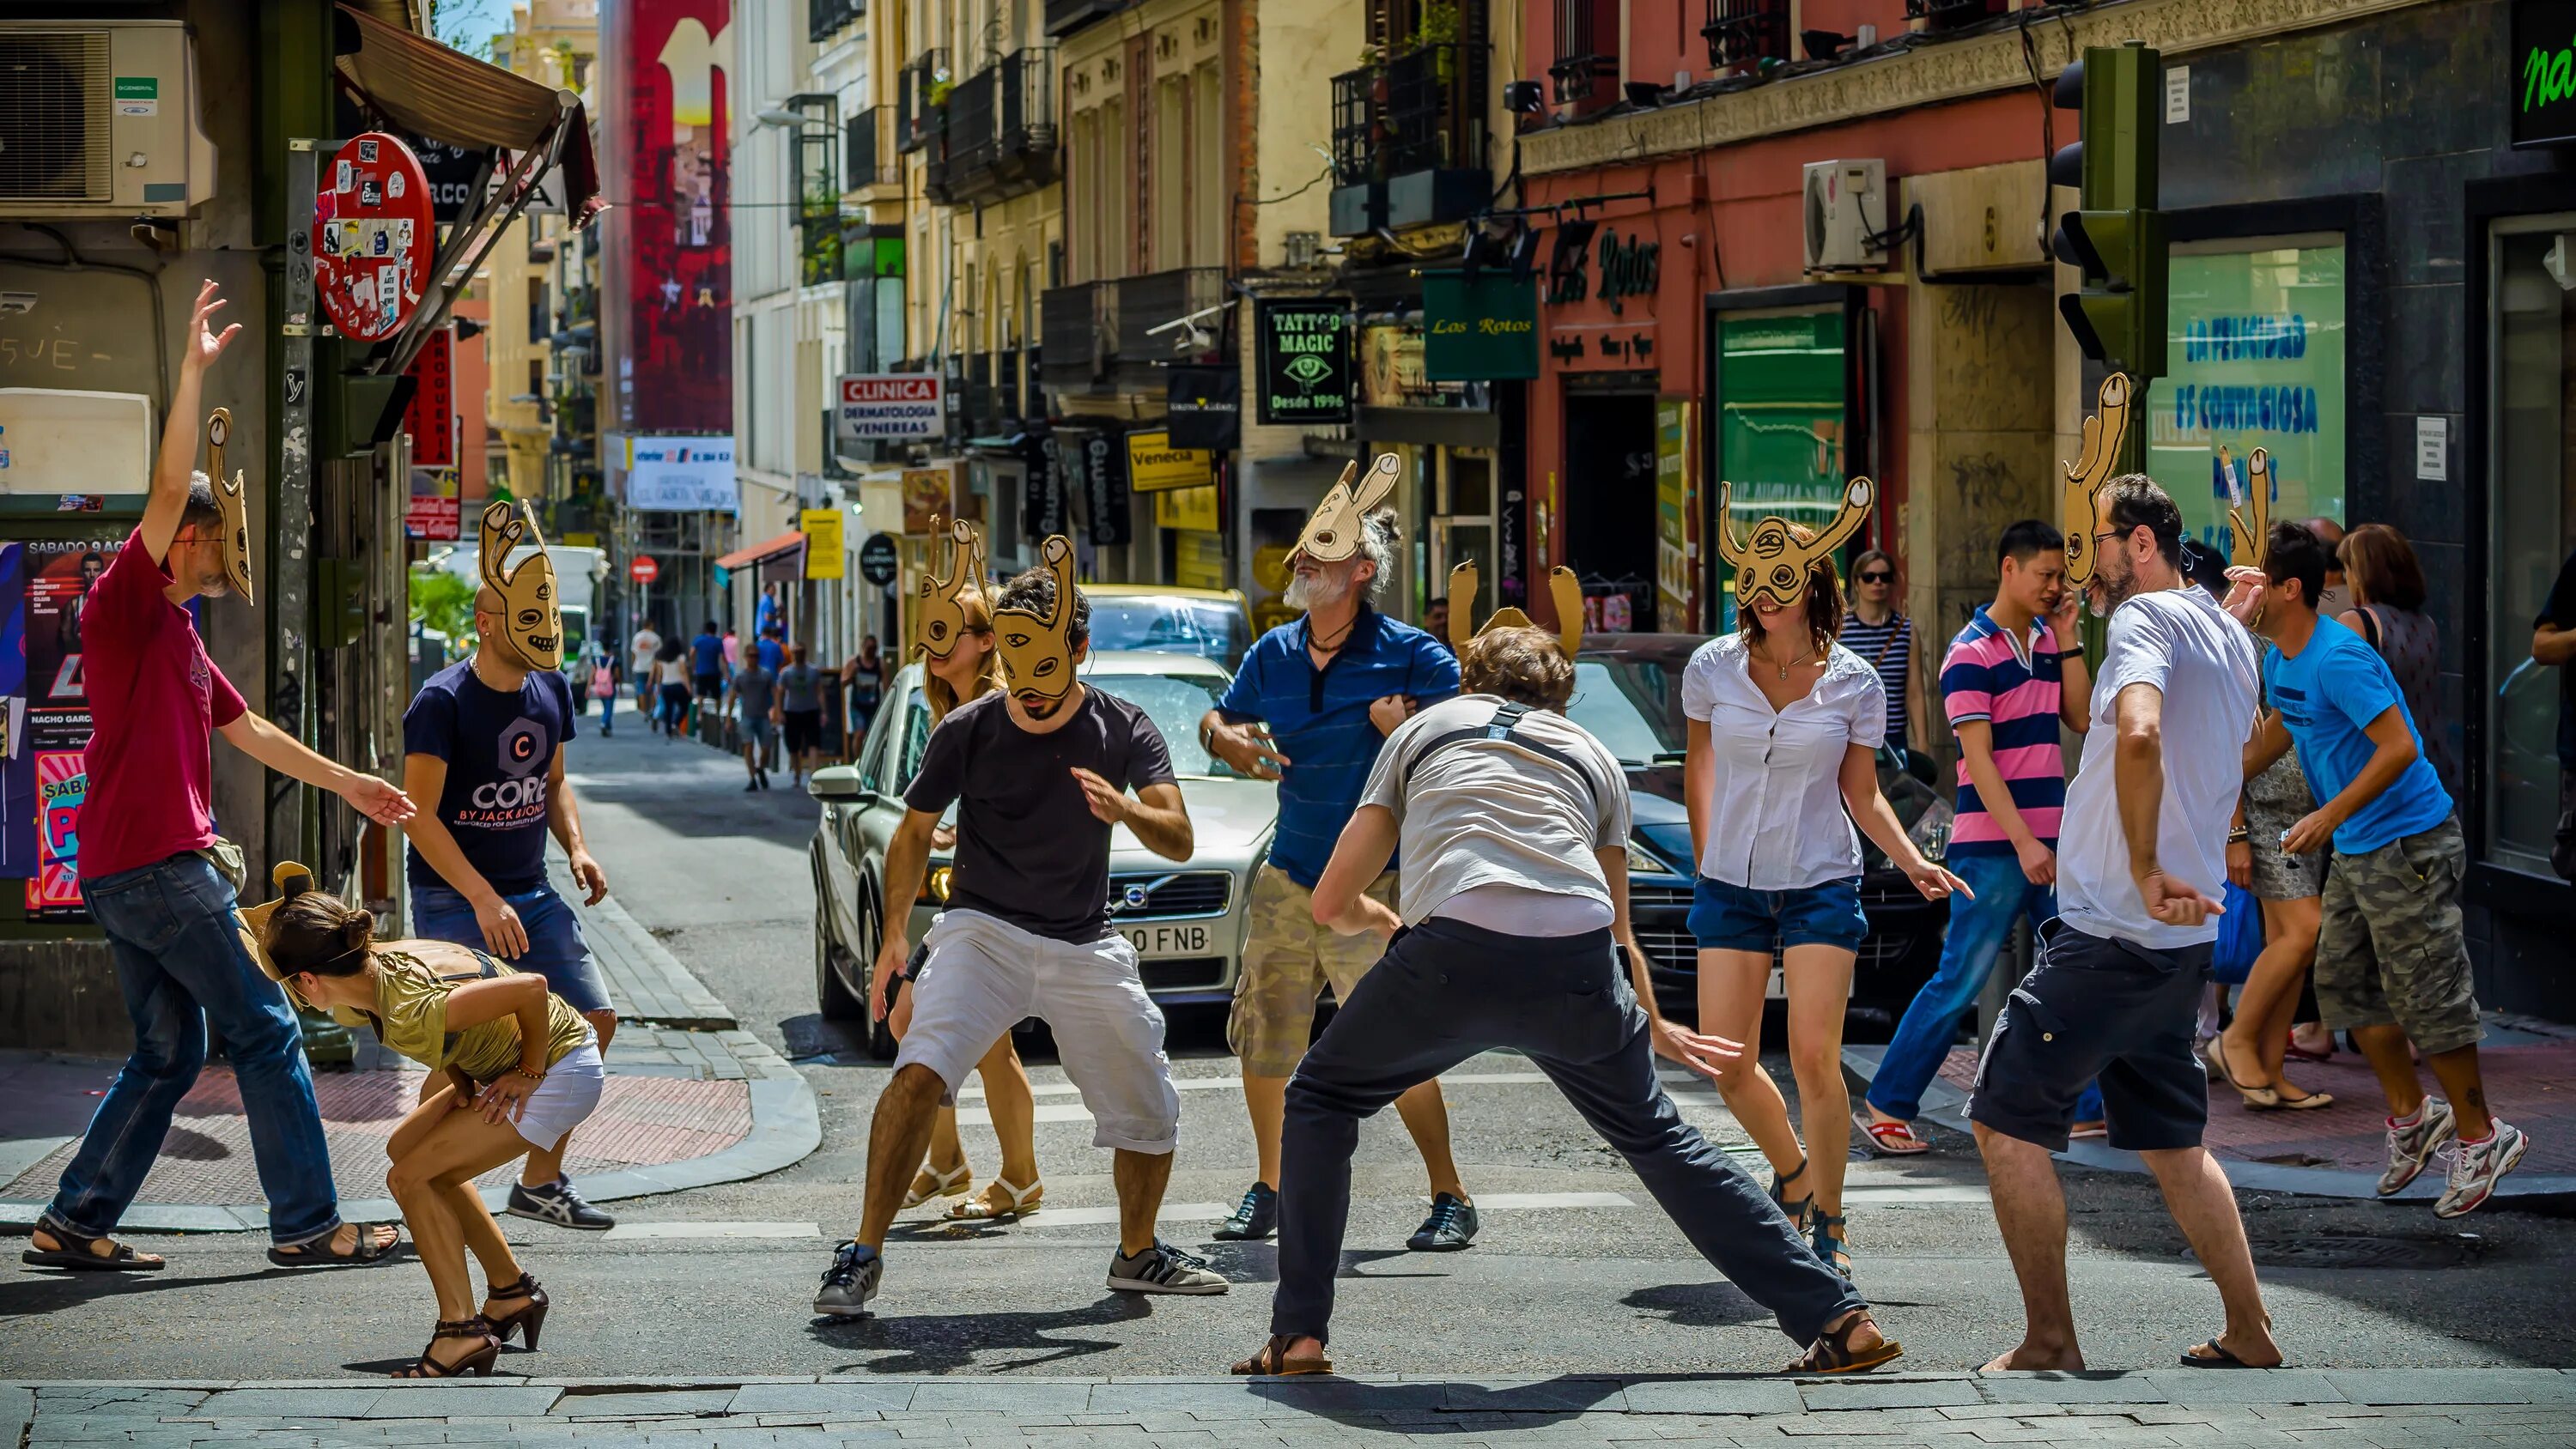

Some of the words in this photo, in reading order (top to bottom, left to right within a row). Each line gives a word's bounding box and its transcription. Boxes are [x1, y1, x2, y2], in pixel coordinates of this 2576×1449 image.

[1279, 334, 1334, 353] MAGIC
[434, 329, 447, 462] DROGUERIA
[848, 381, 933, 400] CLINICA
[1272, 396, 1310, 409] Desde
[1313, 395, 1345, 409] 1996
[2199, 385, 2318, 433] CONTAGIOSA
[844, 405, 937, 420] DERMATOLOGIA
[853, 421, 929, 434] VENEREAS
[1133, 448, 1194, 466] Venecia
[29, 542, 87, 555] SABADO
[91, 542, 101, 553] 9
[104, 541, 125, 553] AG
[31, 715, 64, 724] NACHO
[515, 736, 530, 757] C
[44, 779, 91, 798] SAB
[472, 772, 549, 809] CORE
[453, 819, 491, 828] REINFORCED
[459, 809, 477, 820] BY
[479, 808, 514, 822] JACK
[48, 803, 85, 848] P
[1157, 927, 1206, 952] FNB
